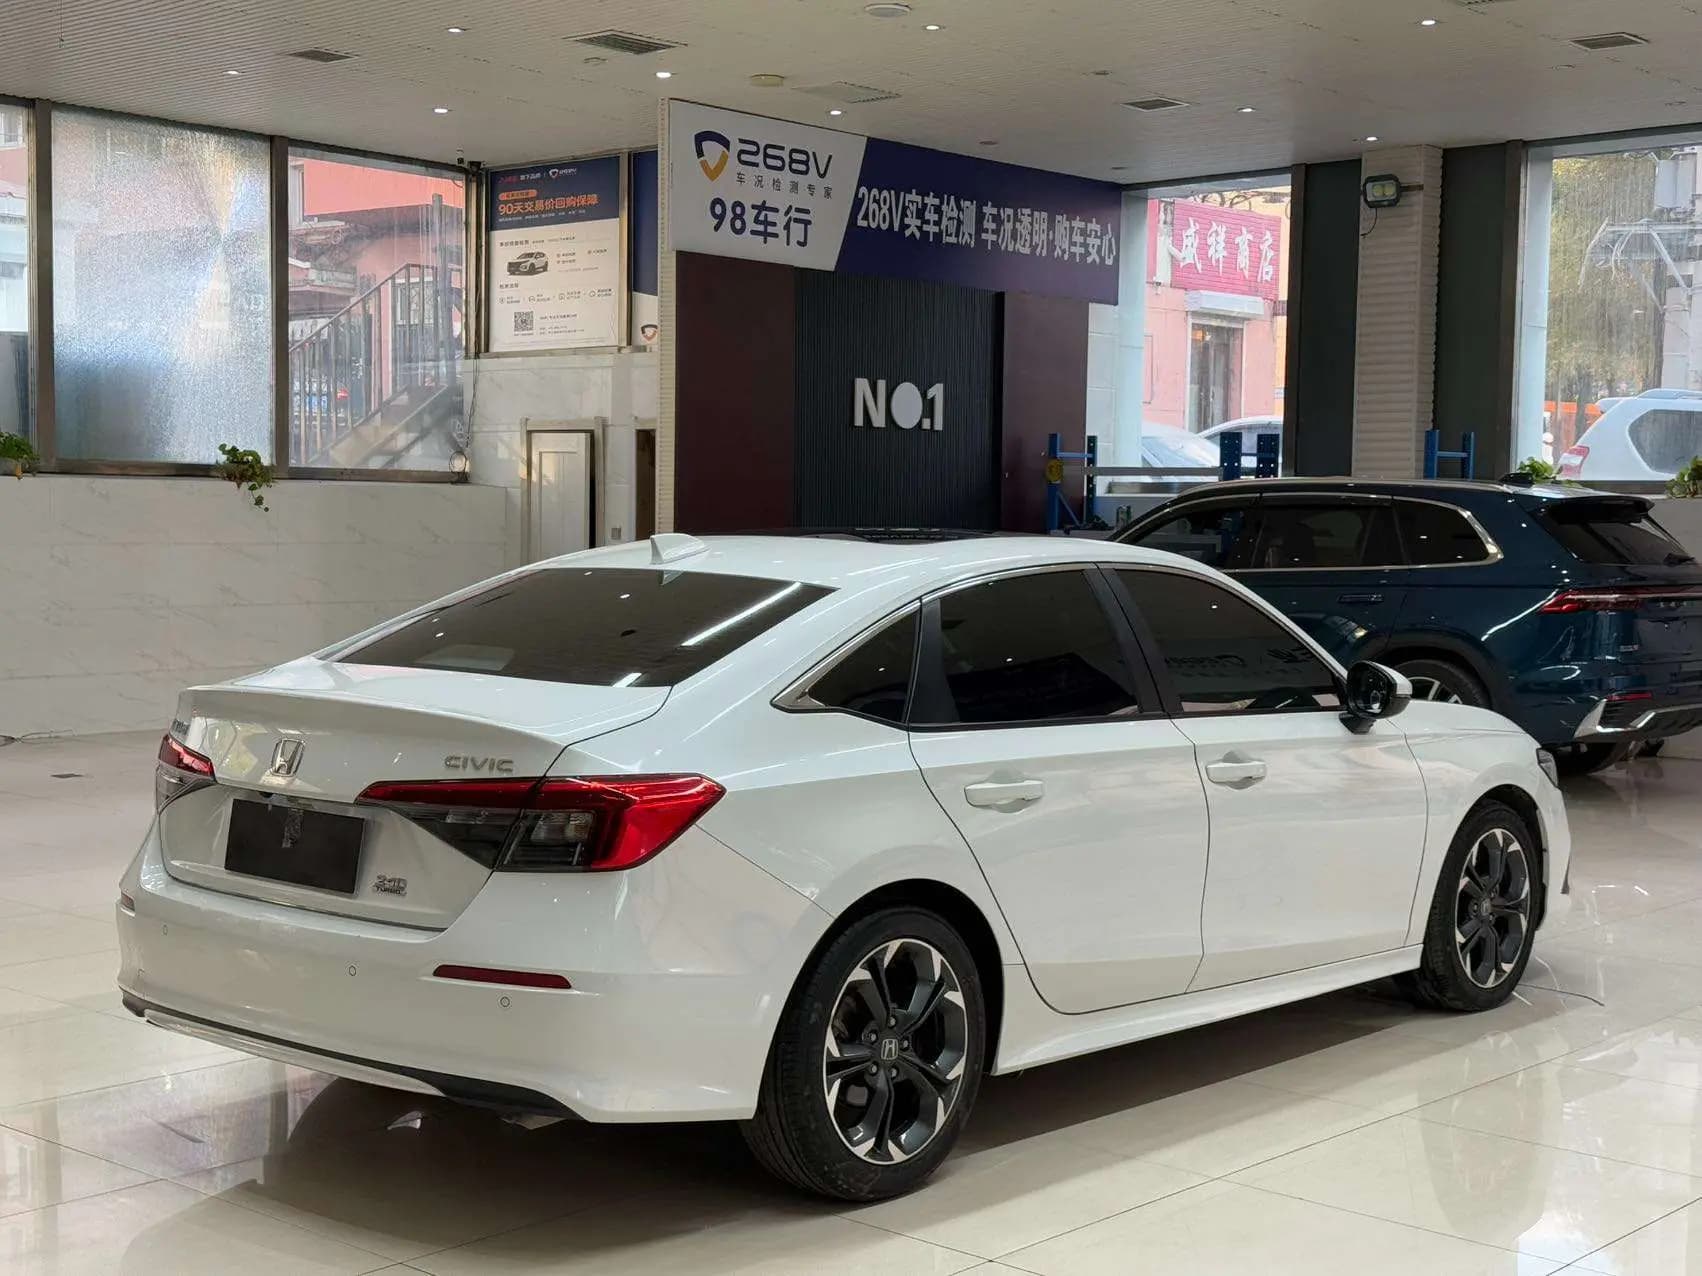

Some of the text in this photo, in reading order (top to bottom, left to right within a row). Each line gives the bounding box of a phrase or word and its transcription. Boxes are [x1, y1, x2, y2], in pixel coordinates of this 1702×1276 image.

[737, 131, 833, 179] 268V
[736, 171, 833, 200] 车况检测专家
[710, 197, 813, 248] 98车行
[856, 186, 977, 249] 268V实车检测
[853, 377, 944, 431] NO.1
[444, 755, 513, 772] CIVIC
